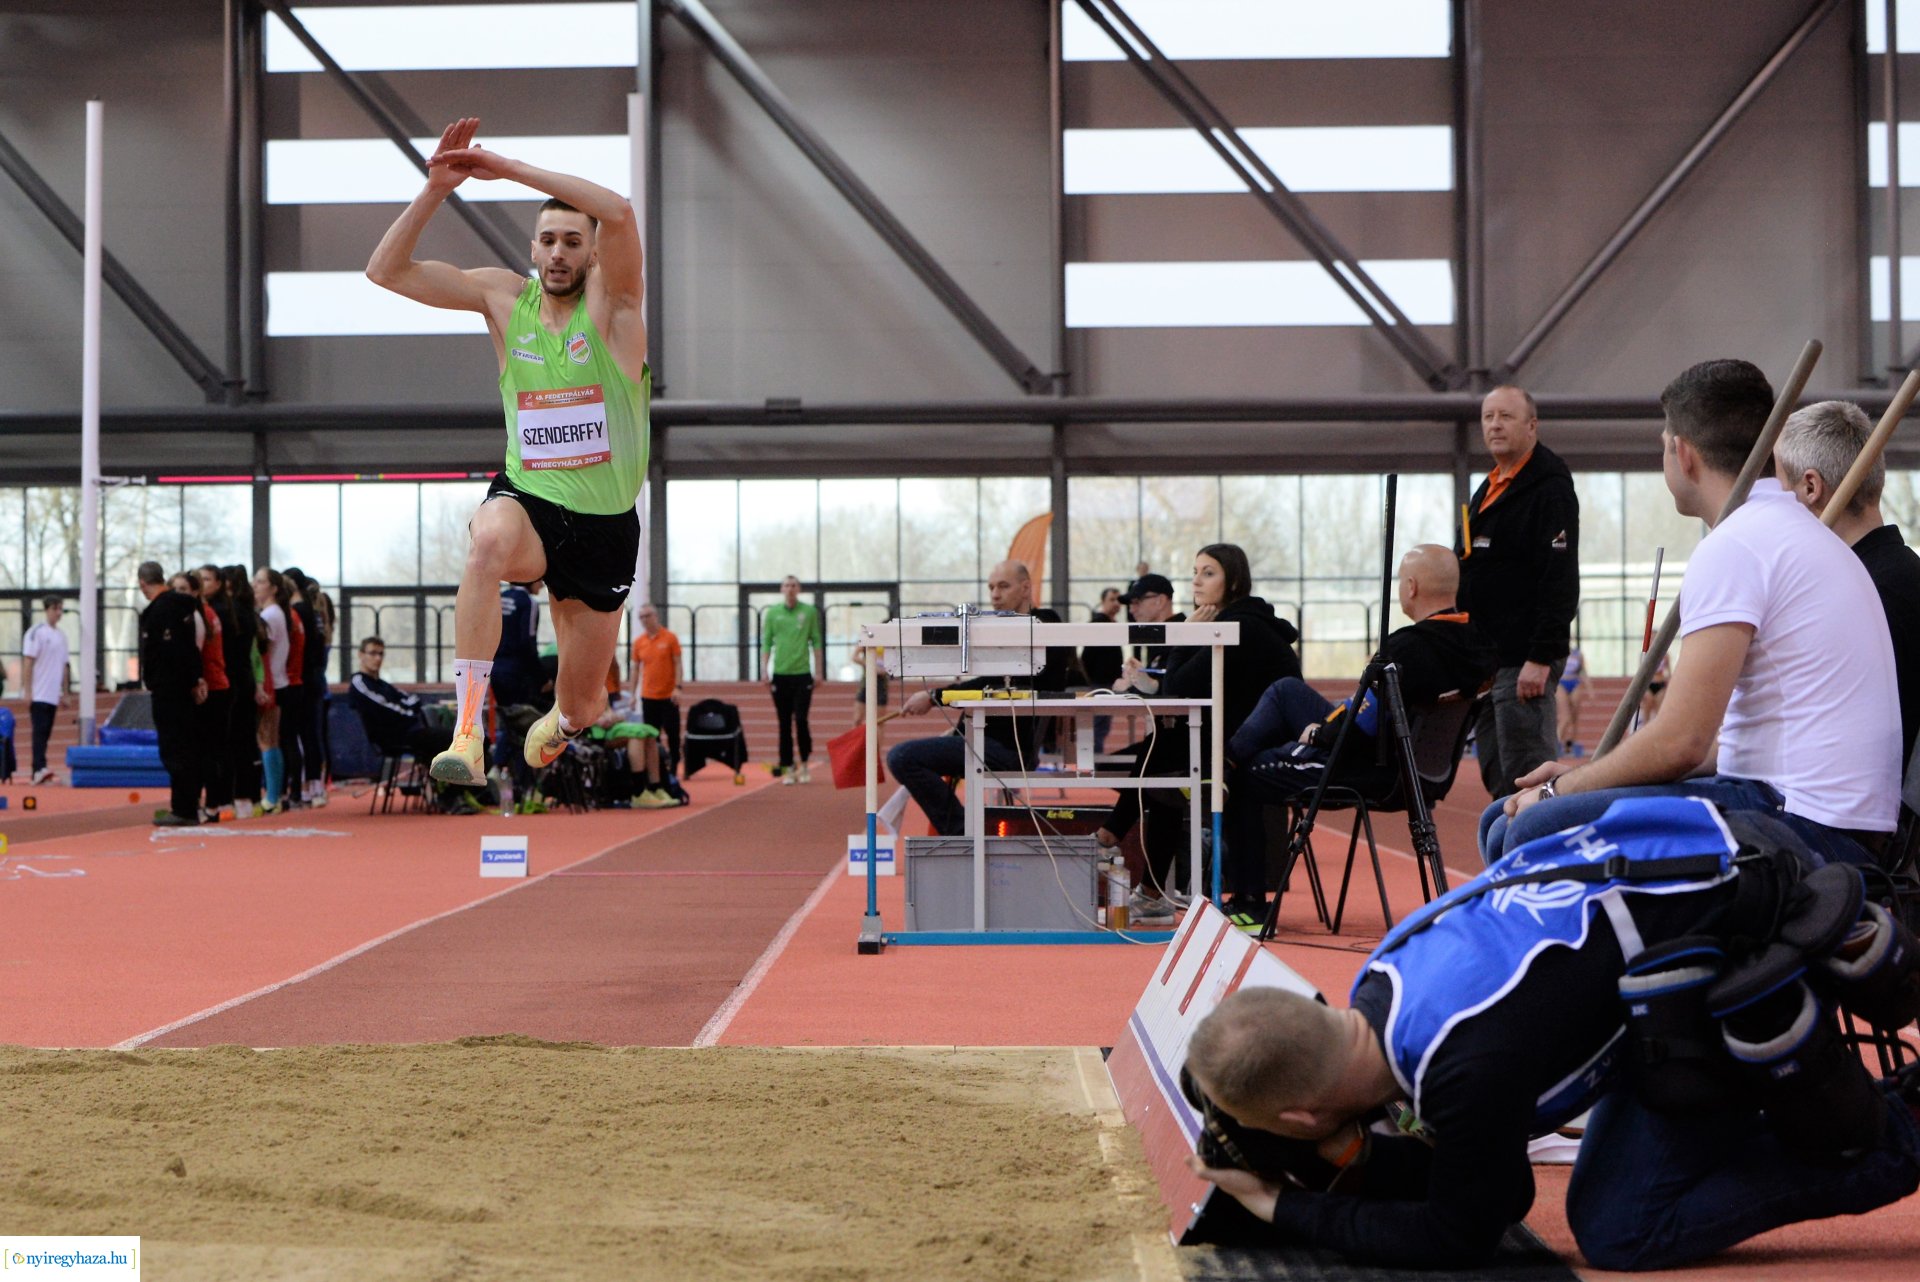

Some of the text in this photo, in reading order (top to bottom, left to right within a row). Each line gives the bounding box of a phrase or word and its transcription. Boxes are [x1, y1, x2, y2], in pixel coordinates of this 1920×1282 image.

[523, 421, 603, 445] SZENDERFFY
[532, 455, 603, 469] NYÍREGYHÁZA 2023
